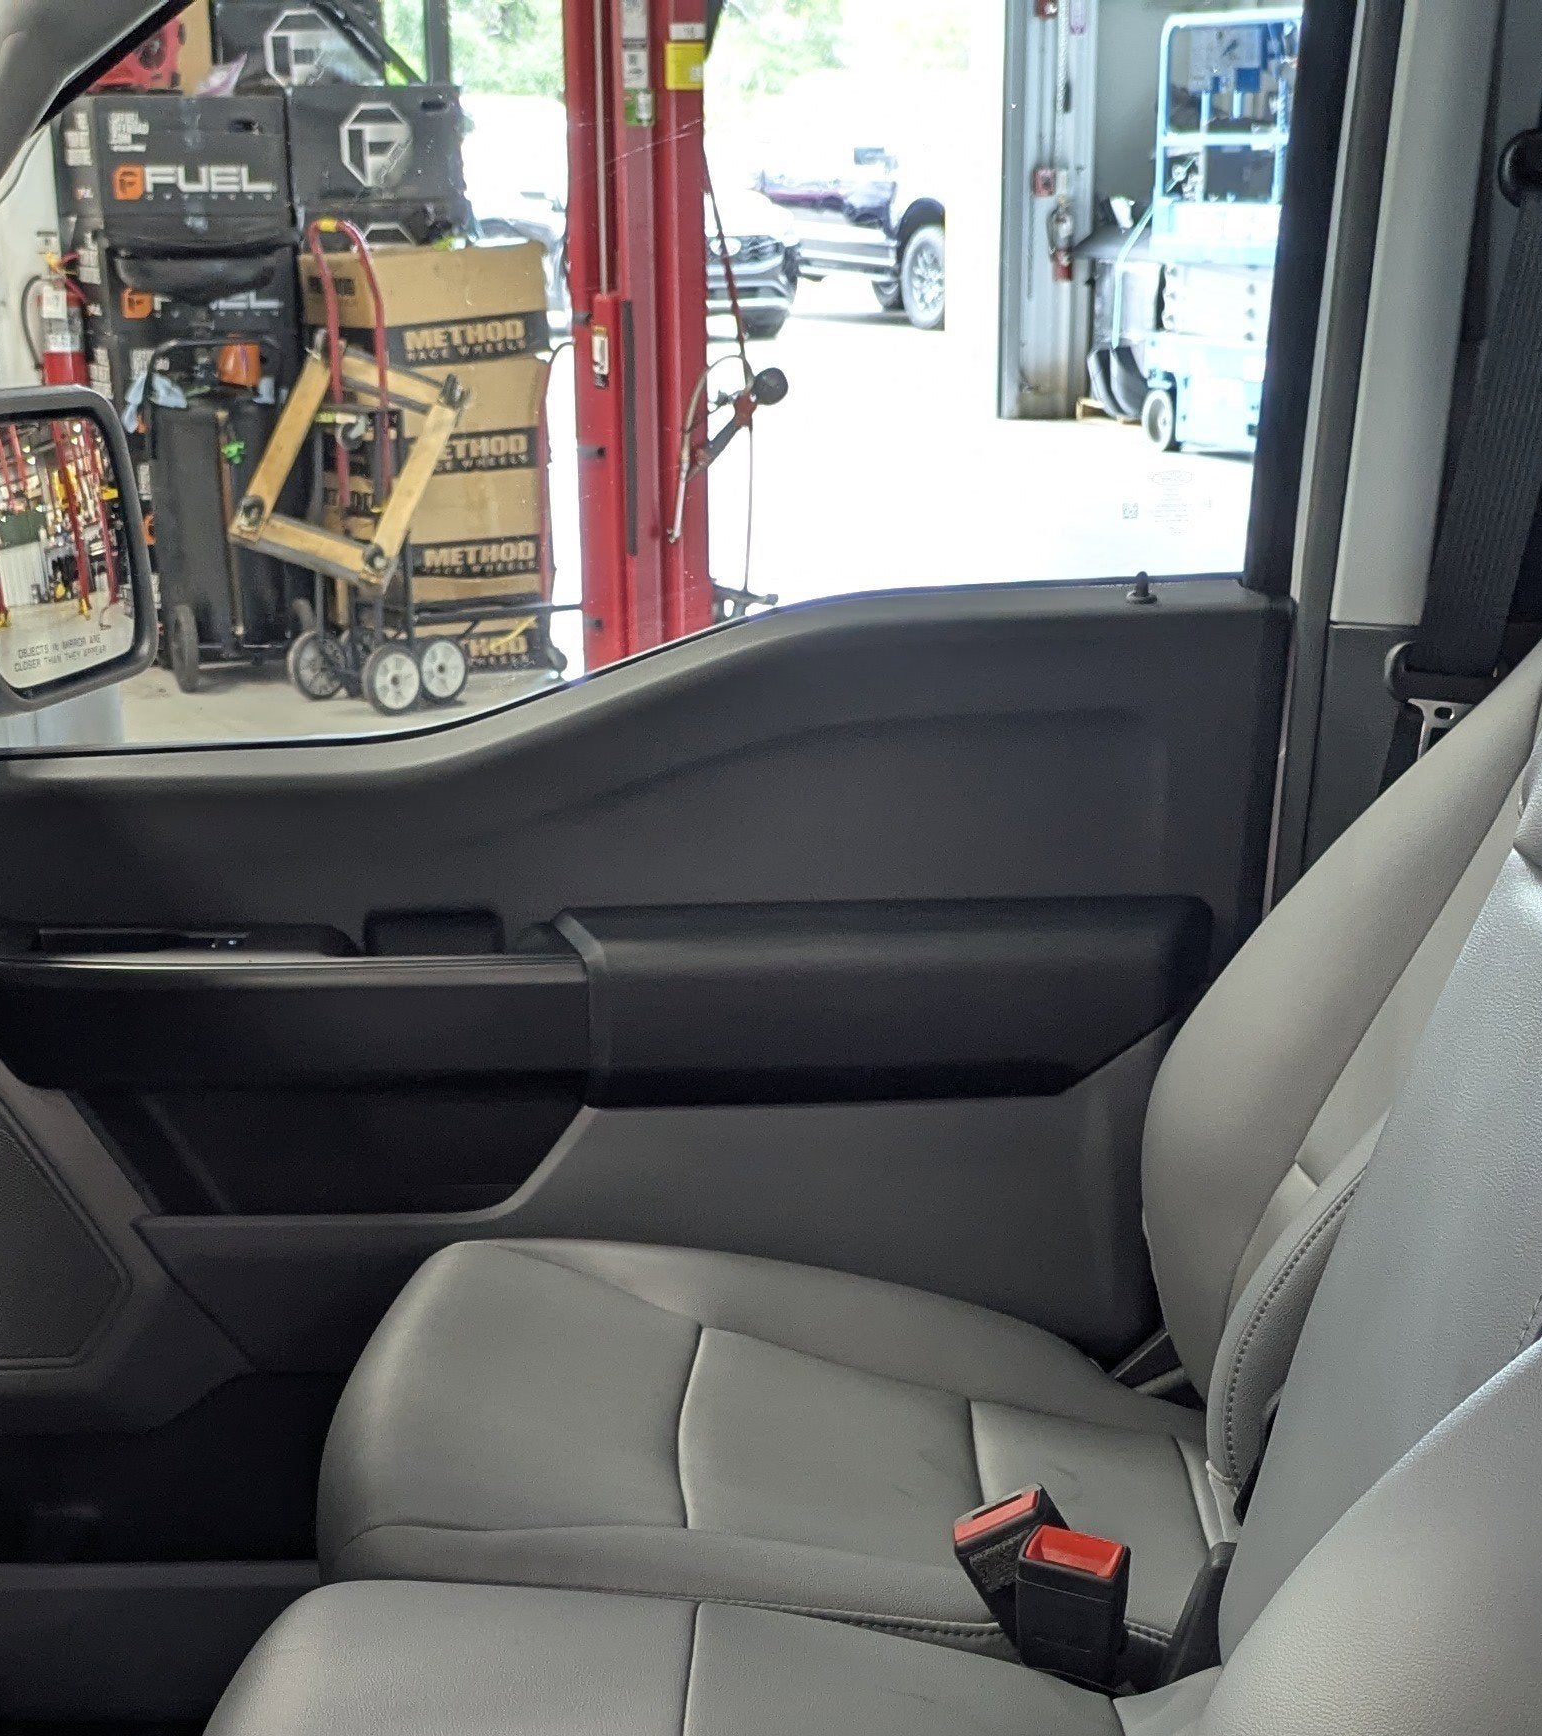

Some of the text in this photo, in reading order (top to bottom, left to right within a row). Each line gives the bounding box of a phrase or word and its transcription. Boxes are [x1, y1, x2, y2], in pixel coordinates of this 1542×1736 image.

[143, 165, 277, 193] FUEL
[403, 318, 526, 350] METHOD
[443, 434, 528, 459] ETHOD
[422, 540, 536, 567] METHOD
